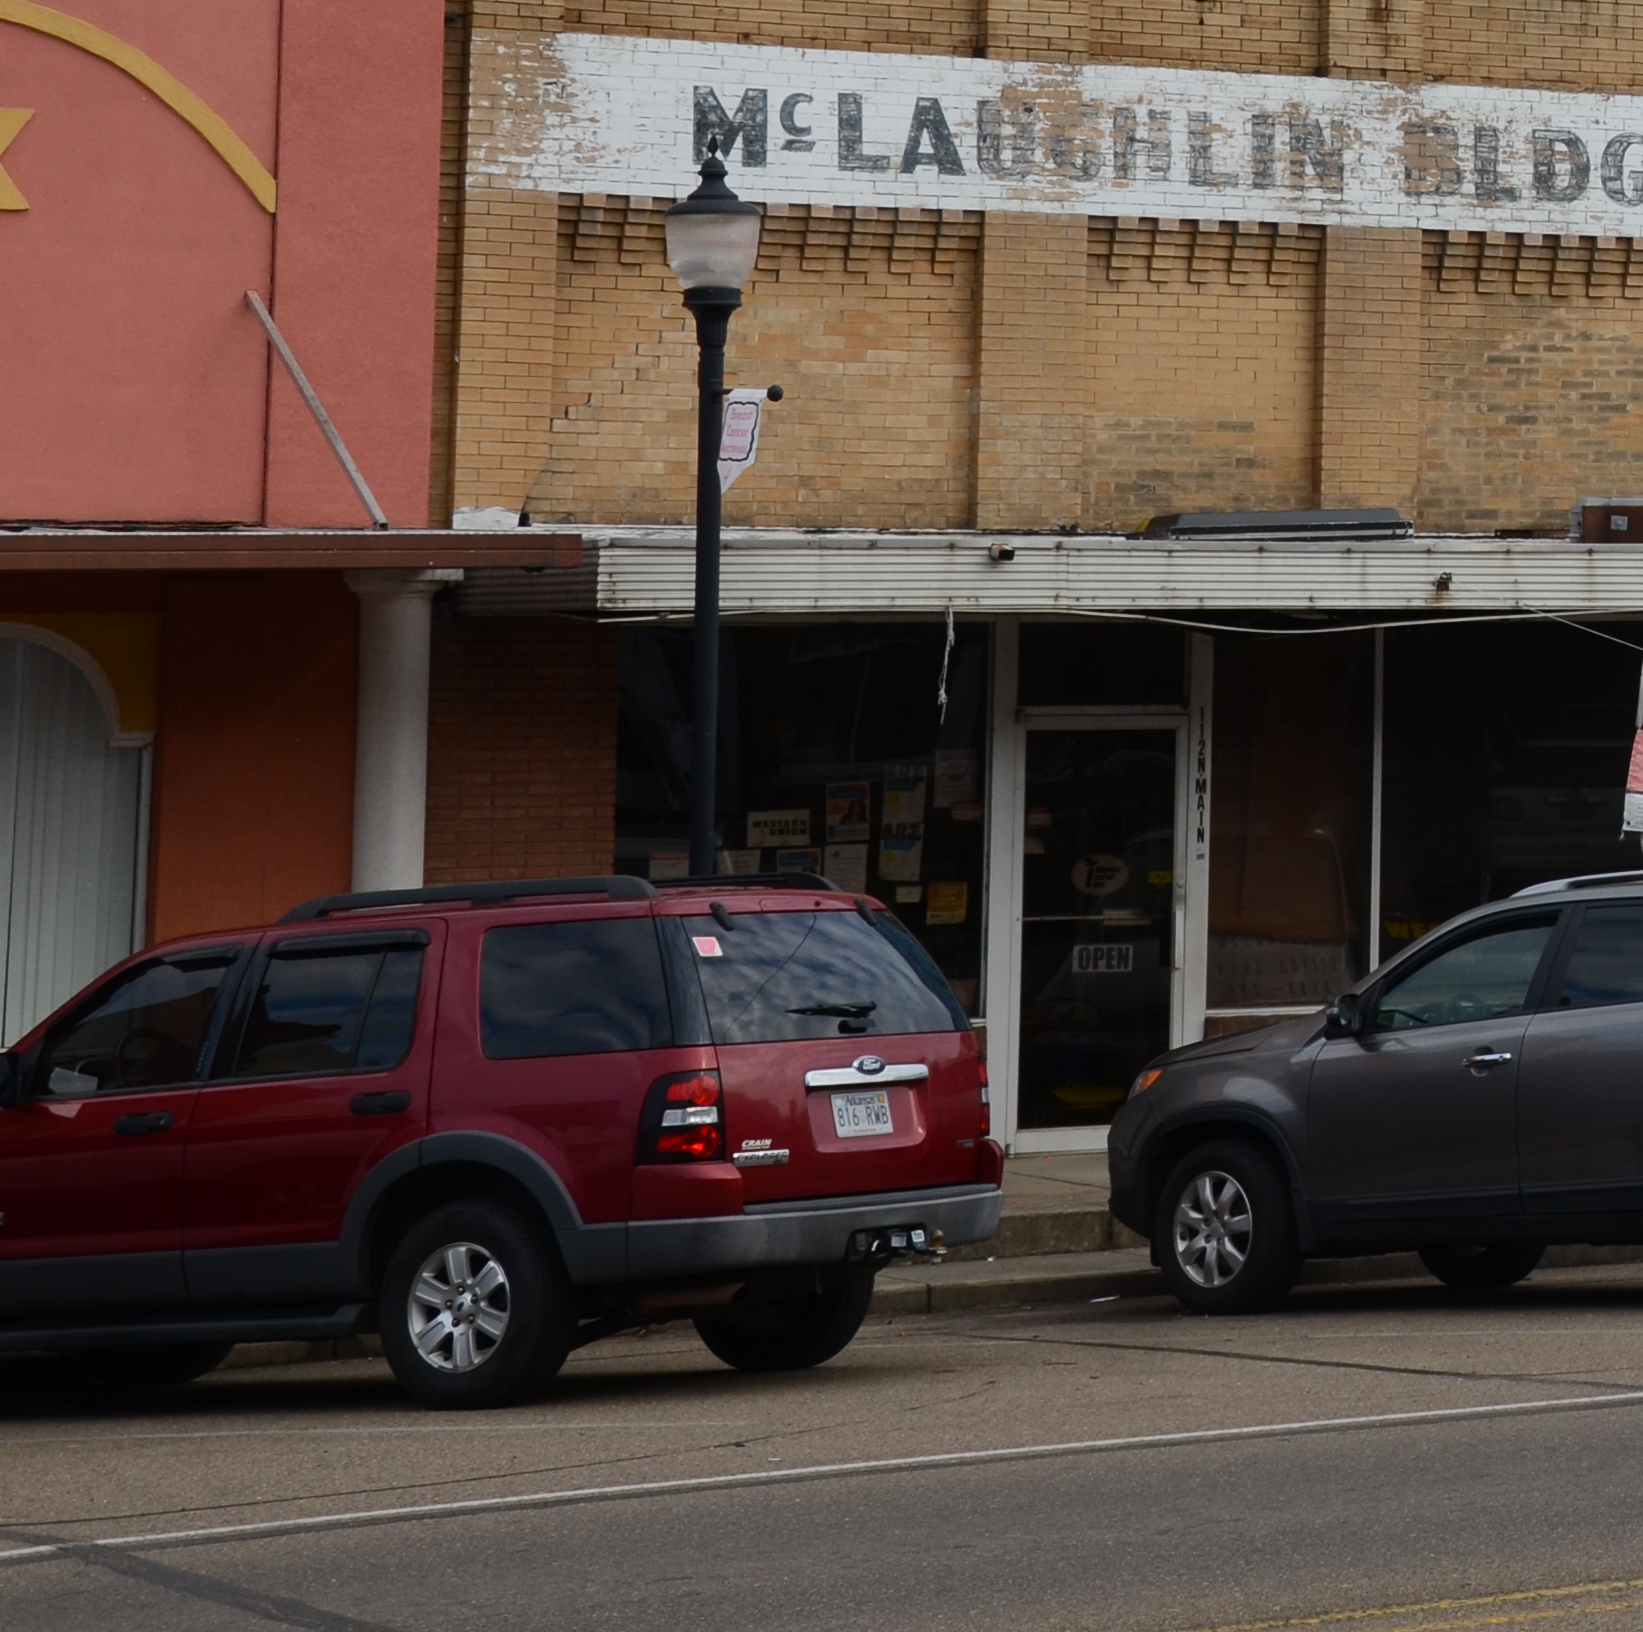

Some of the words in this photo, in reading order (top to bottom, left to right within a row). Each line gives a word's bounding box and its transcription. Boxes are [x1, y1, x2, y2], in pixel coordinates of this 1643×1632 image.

[1195, 778, 1207, 844] MAIN
[752, 820, 807, 828] WESTERN
[769, 828, 807, 836] UNION
[1078, 947, 1130, 970] OPEN
[846, 1095, 876, 1106] Arkansas
[837, 1107, 859, 1127] 816
[865, 1105, 889, 1126] RWB
[742, 1139, 772, 1148] CRAIN
